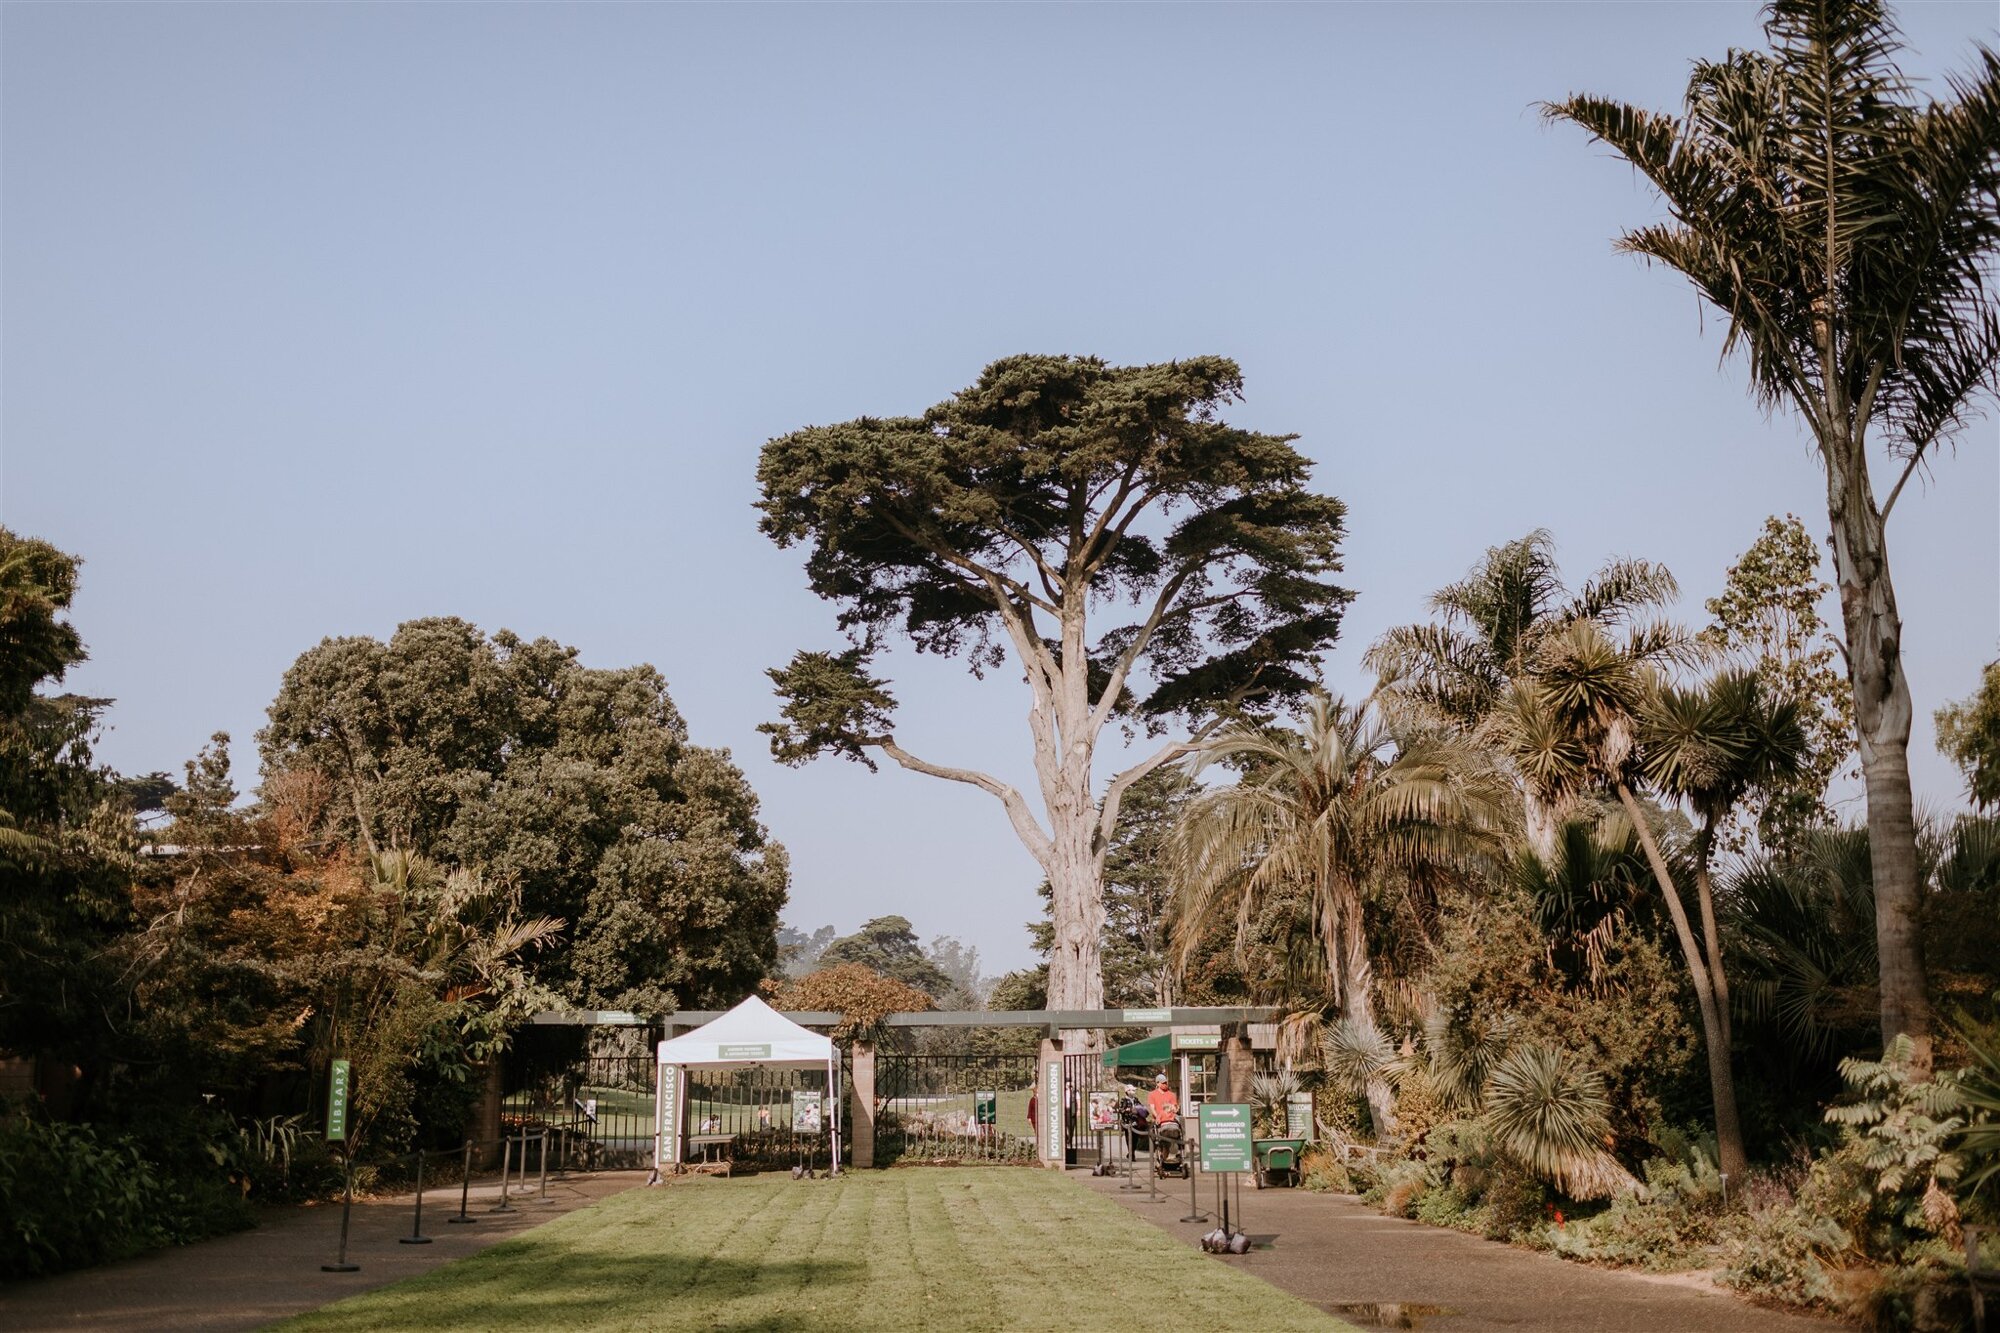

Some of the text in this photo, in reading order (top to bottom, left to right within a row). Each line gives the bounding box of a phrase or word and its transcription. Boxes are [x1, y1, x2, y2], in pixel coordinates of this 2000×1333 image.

[332, 1067, 345, 1132] LIBRARY
[663, 1066, 675, 1160] SAN FRANCISCO
[1050, 1064, 1059, 1157] BOTANICAL GARDEN
